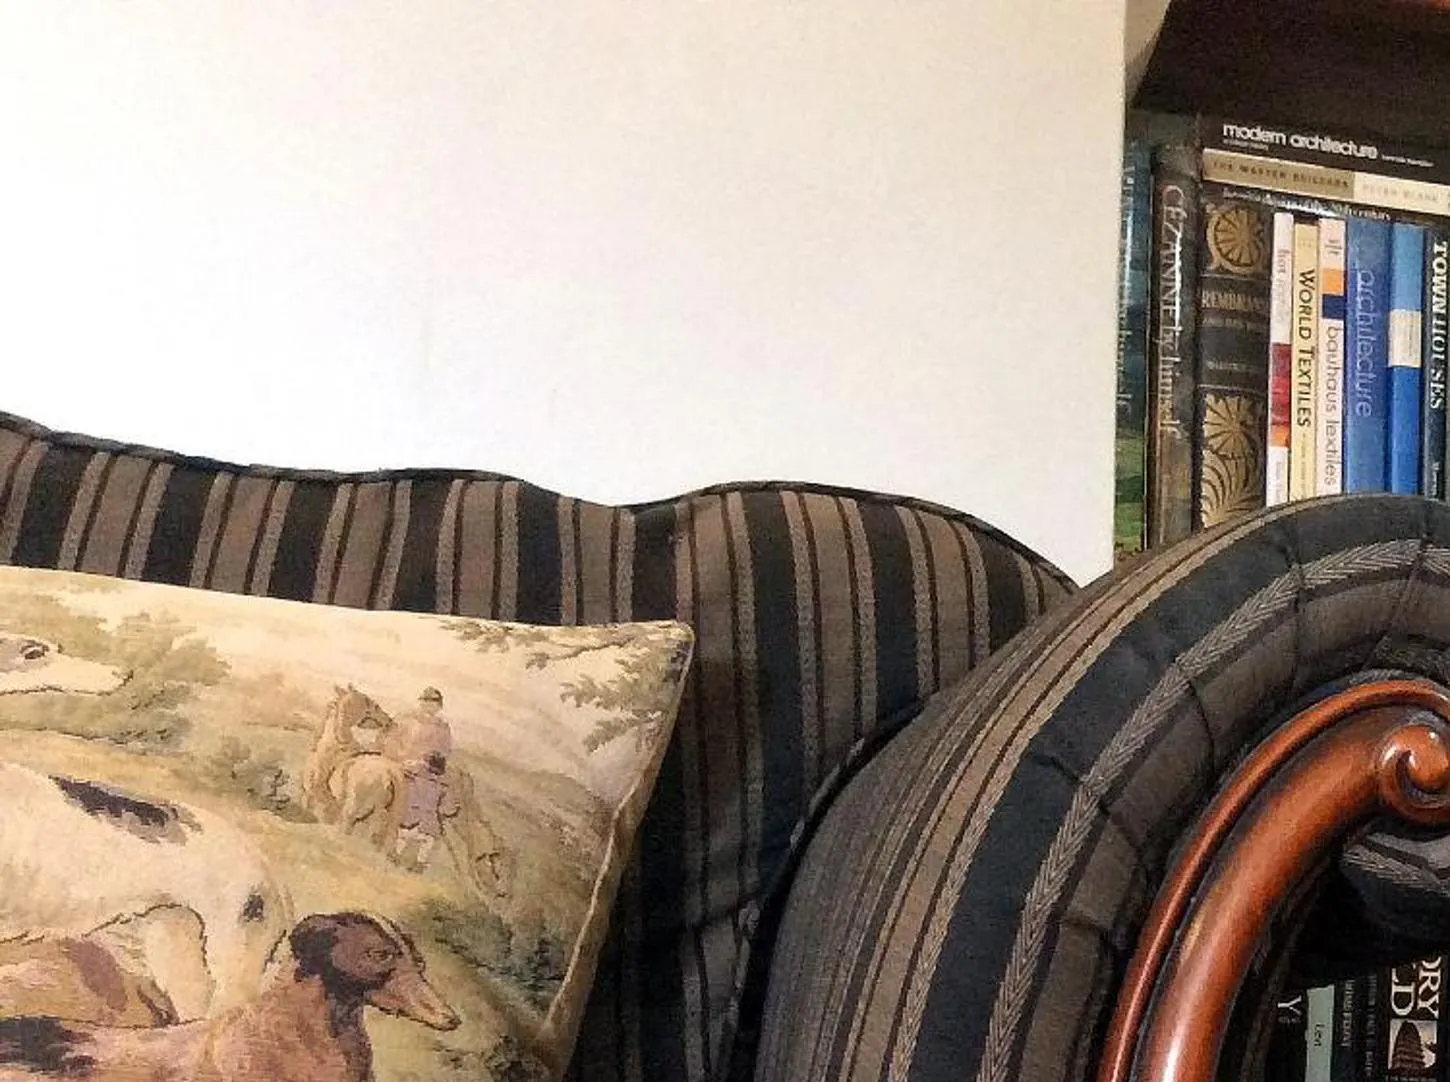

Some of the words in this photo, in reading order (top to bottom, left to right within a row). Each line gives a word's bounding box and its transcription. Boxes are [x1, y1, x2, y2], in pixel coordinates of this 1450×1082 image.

[1223, 124, 1287, 146] modern
[1290, 134, 1378, 159] architecture
[1240, 164, 1286, 180] MASTER
[1298, 269, 1316, 341] WORLD
[1355, 269, 1376, 417] architecture
[1158, 355, 1182, 440] himself
[1296, 345, 1316, 427] TEXTILES
[1325, 327, 1340, 413] bauhaus
[1323, 417, 1339, 486] textiles
